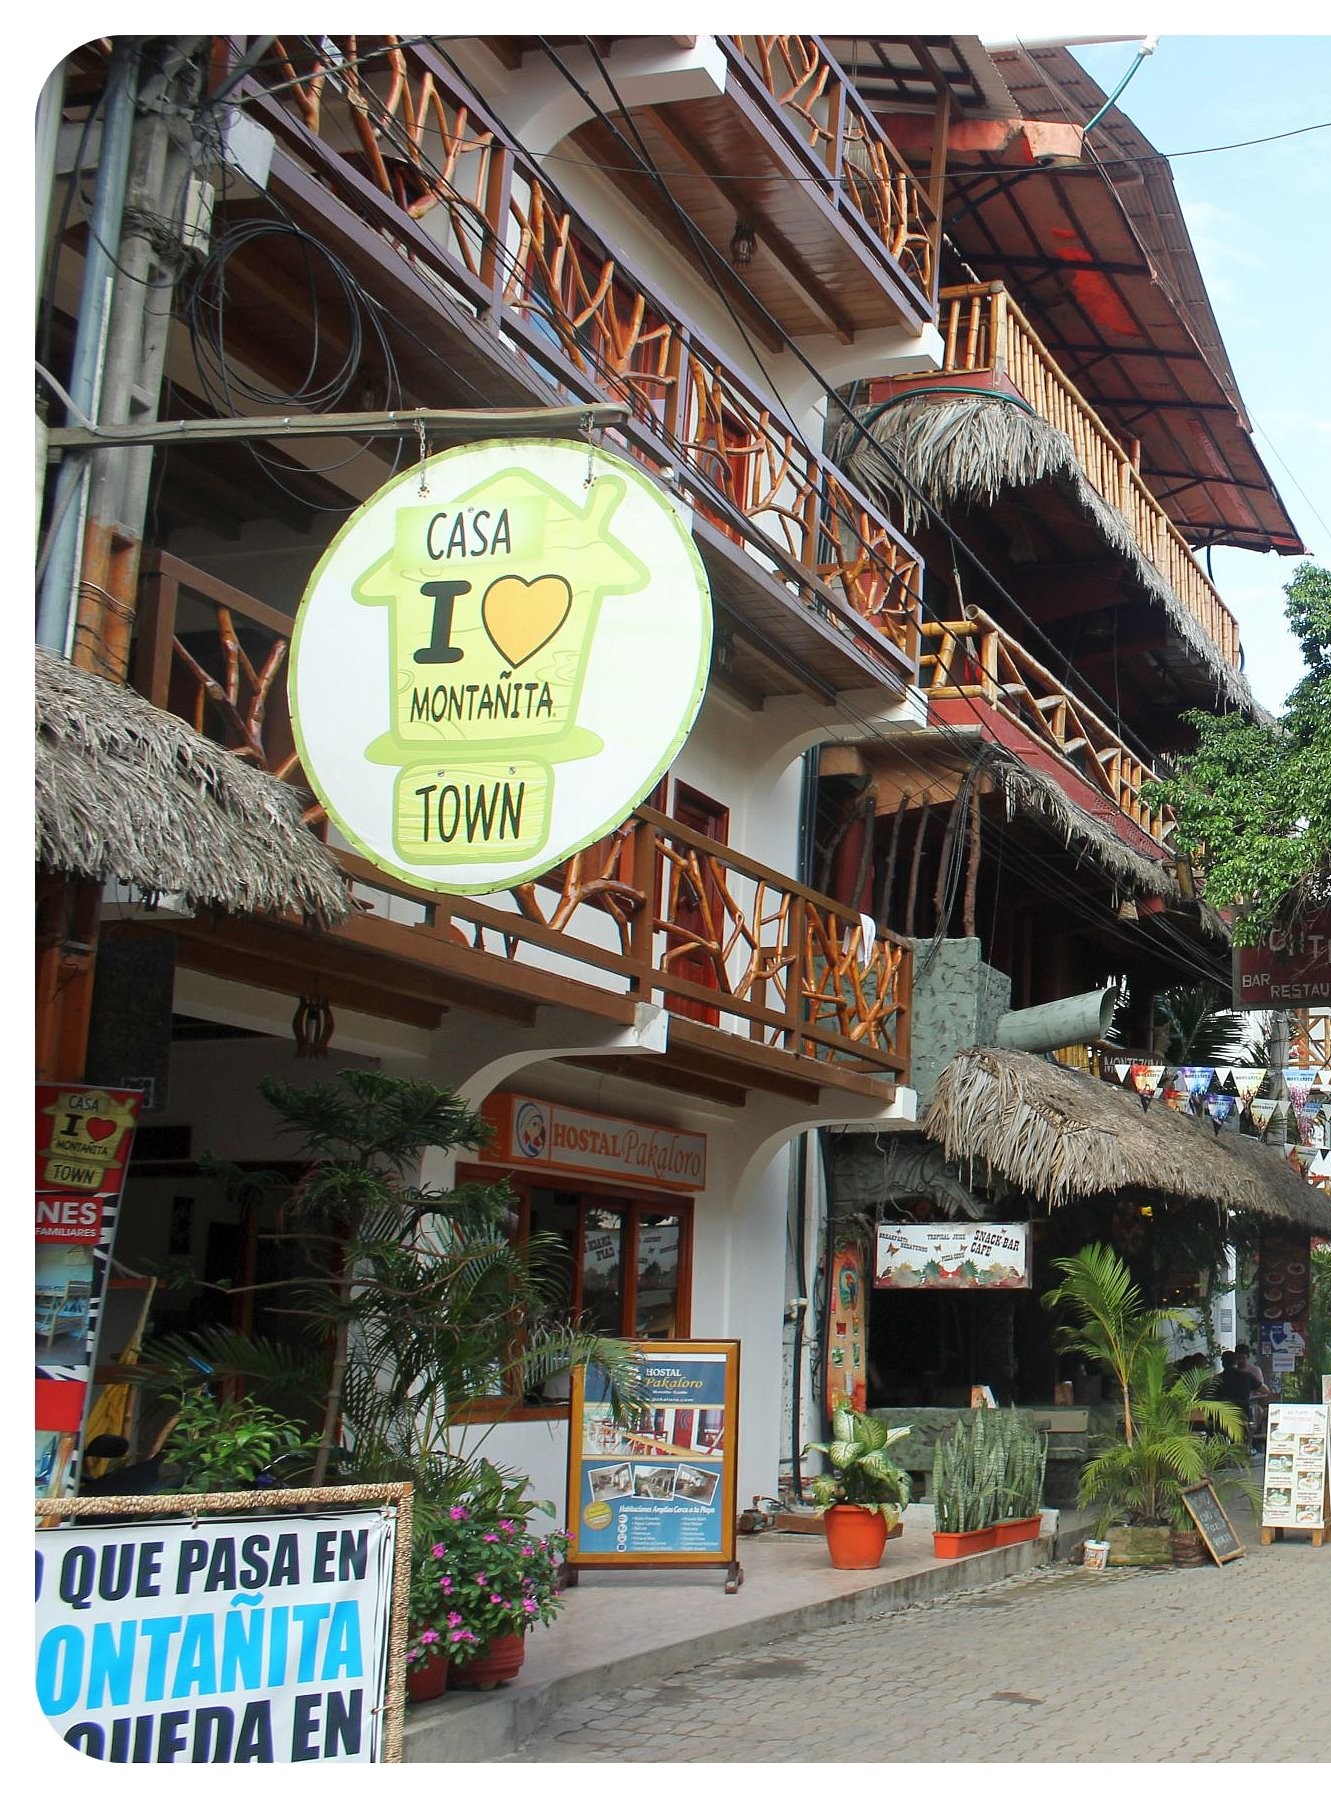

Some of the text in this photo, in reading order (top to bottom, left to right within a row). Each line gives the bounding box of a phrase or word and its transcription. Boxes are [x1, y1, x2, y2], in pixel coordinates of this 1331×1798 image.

[426, 508, 512, 561] CASA
[412, 580, 472, 664] I
[410, 670, 554, 723] MONTAÑITA
[415, 782, 525, 843] TOWN
[1242, 973, 1271, 988] BAR
[68, 1095, 99, 1112] CASA
[60, 1113, 84, 1137] I
[553, 1123, 700, 1178] HOSTAL Pakaloro
[52, 1164, 97, 1185] TOWN
[970, 1242, 992, 1257] CAFE
[973, 1230, 1020, 1251] SNACK-BAR
[644, 1376, 703, 1390] Pakaloro
[645, 1368, 682, 1377] HOSTAL
[59, 1541, 165, 1610] QUE
[175, 1533, 300, 1595] PASA
[312, 1529, 370, 1584] EN
[35, 1591, 364, 1717] ONTAÑITA
[290, 1688, 364, 1764] EN
